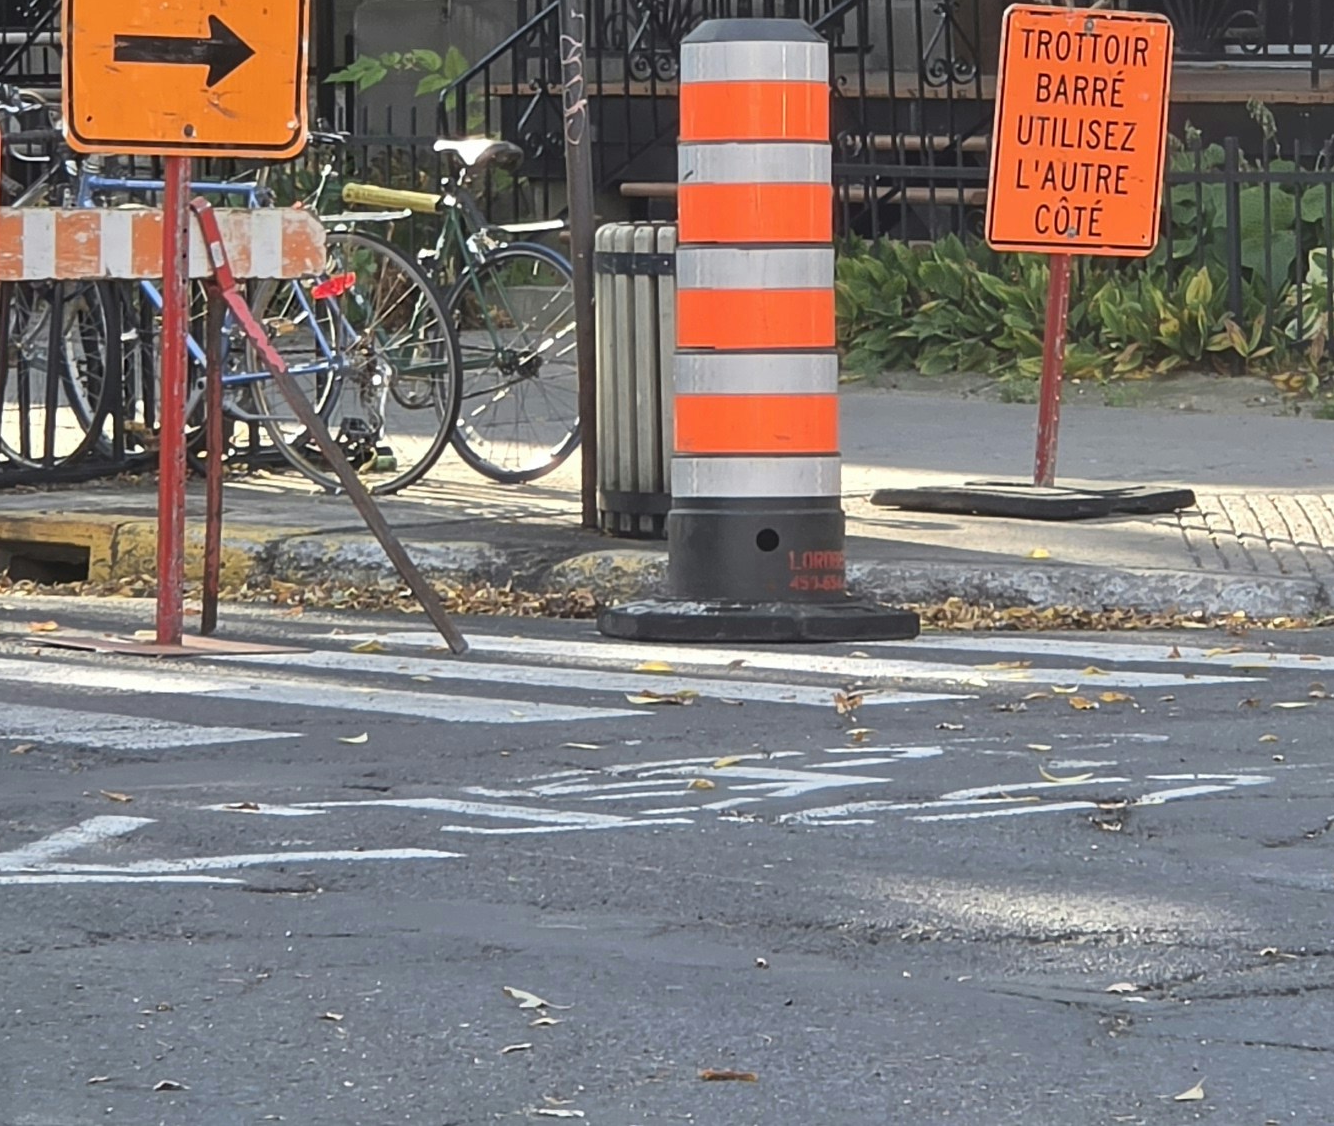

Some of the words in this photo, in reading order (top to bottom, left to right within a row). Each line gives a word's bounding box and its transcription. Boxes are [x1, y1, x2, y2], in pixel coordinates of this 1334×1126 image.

[1021, 28, 1149, 67] TROTTOIR
[1035, 70, 1125, 108] BARRÉ
[1017, 114, 1137, 152] UTILISEZ
[1016, 158, 1129, 195] L'AUTRE
[1034, 196, 1103, 237] CÔTÉ
